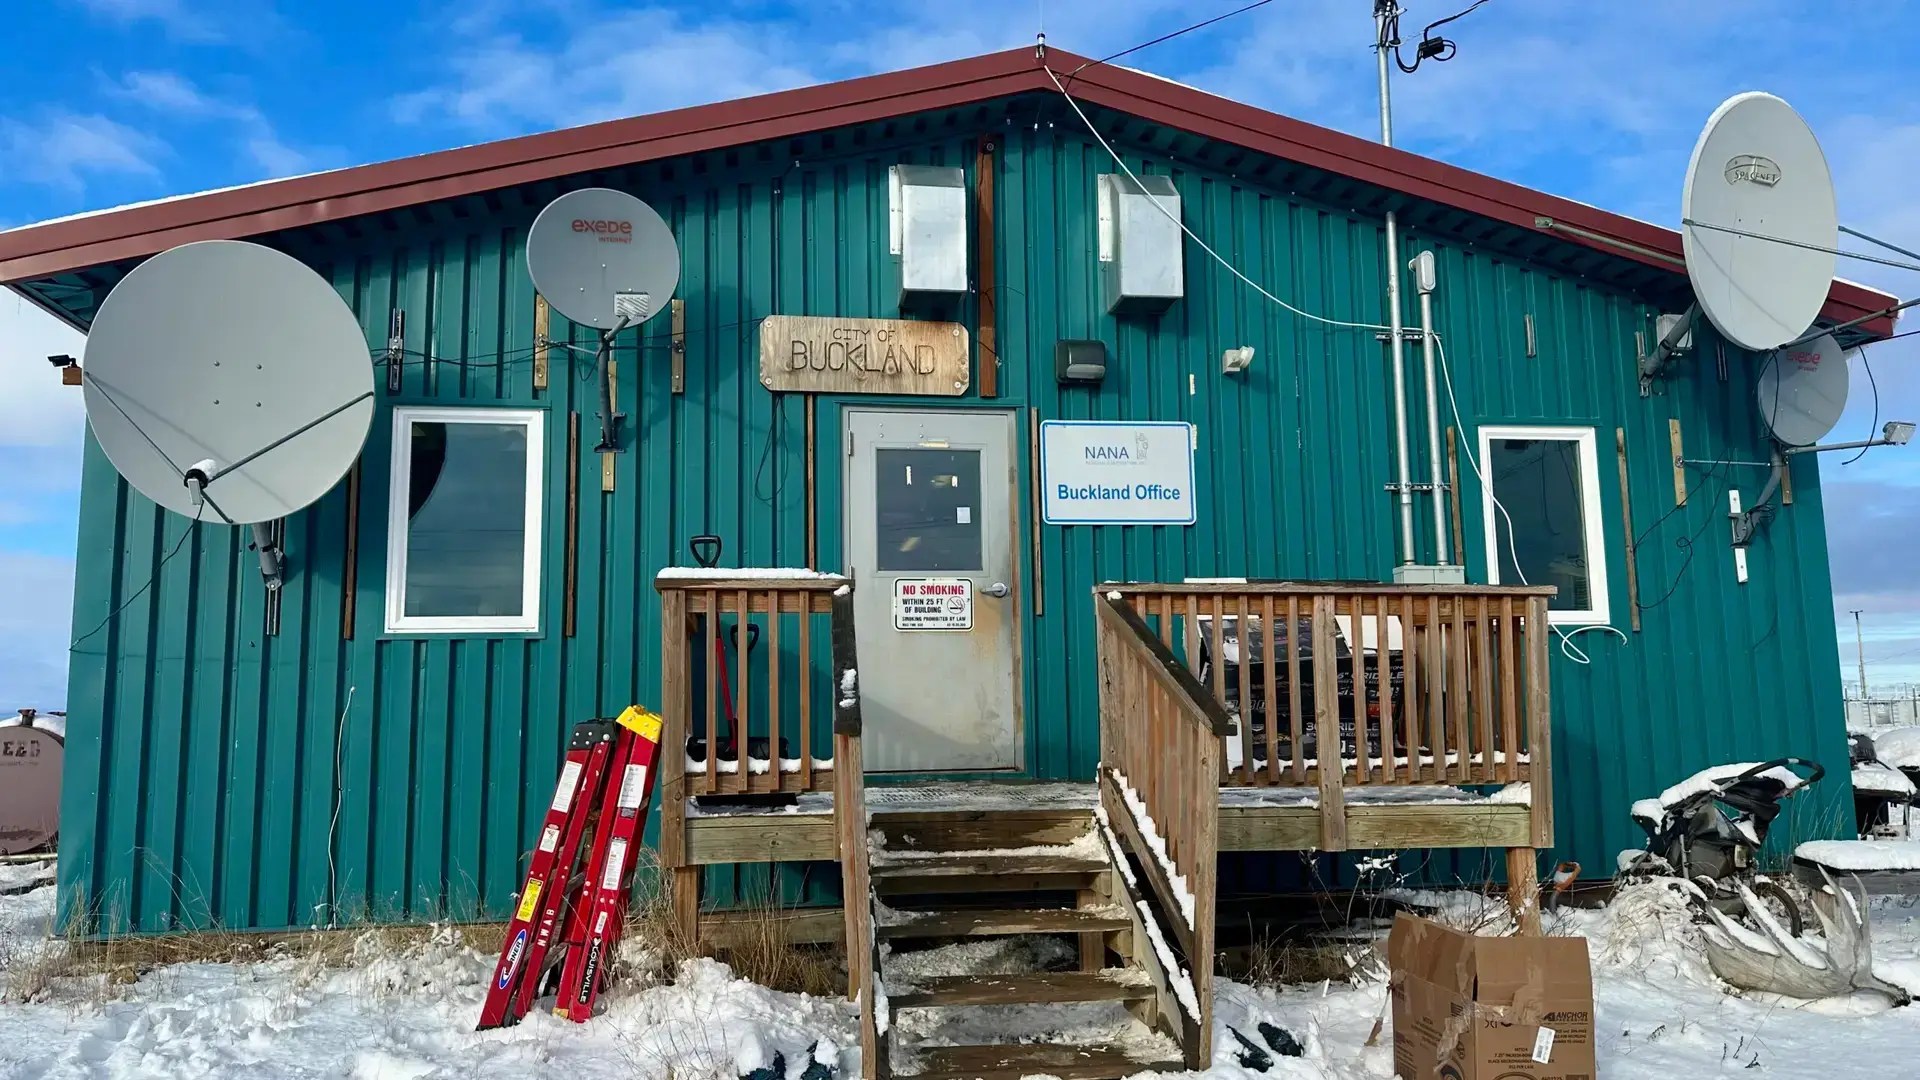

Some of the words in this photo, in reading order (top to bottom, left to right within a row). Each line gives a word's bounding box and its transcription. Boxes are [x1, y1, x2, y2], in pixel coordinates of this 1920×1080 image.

[832, 328, 870, 341] CITY
[877, 329, 896, 343] OF
[791, 340, 936, 375] BUCKLAND
[1084, 446, 1130, 459] NANA
[1057, 484, 1130, 500] Buckland
[1135, 484, 1181, 500] Office
[902, 585, 916, 595] NO
[920, 585, 964, 595] SMOKING
[580, 945, 599, 1004] LOUISVILLE
[1556, 1011, 1588, 1019] ANCHOR
